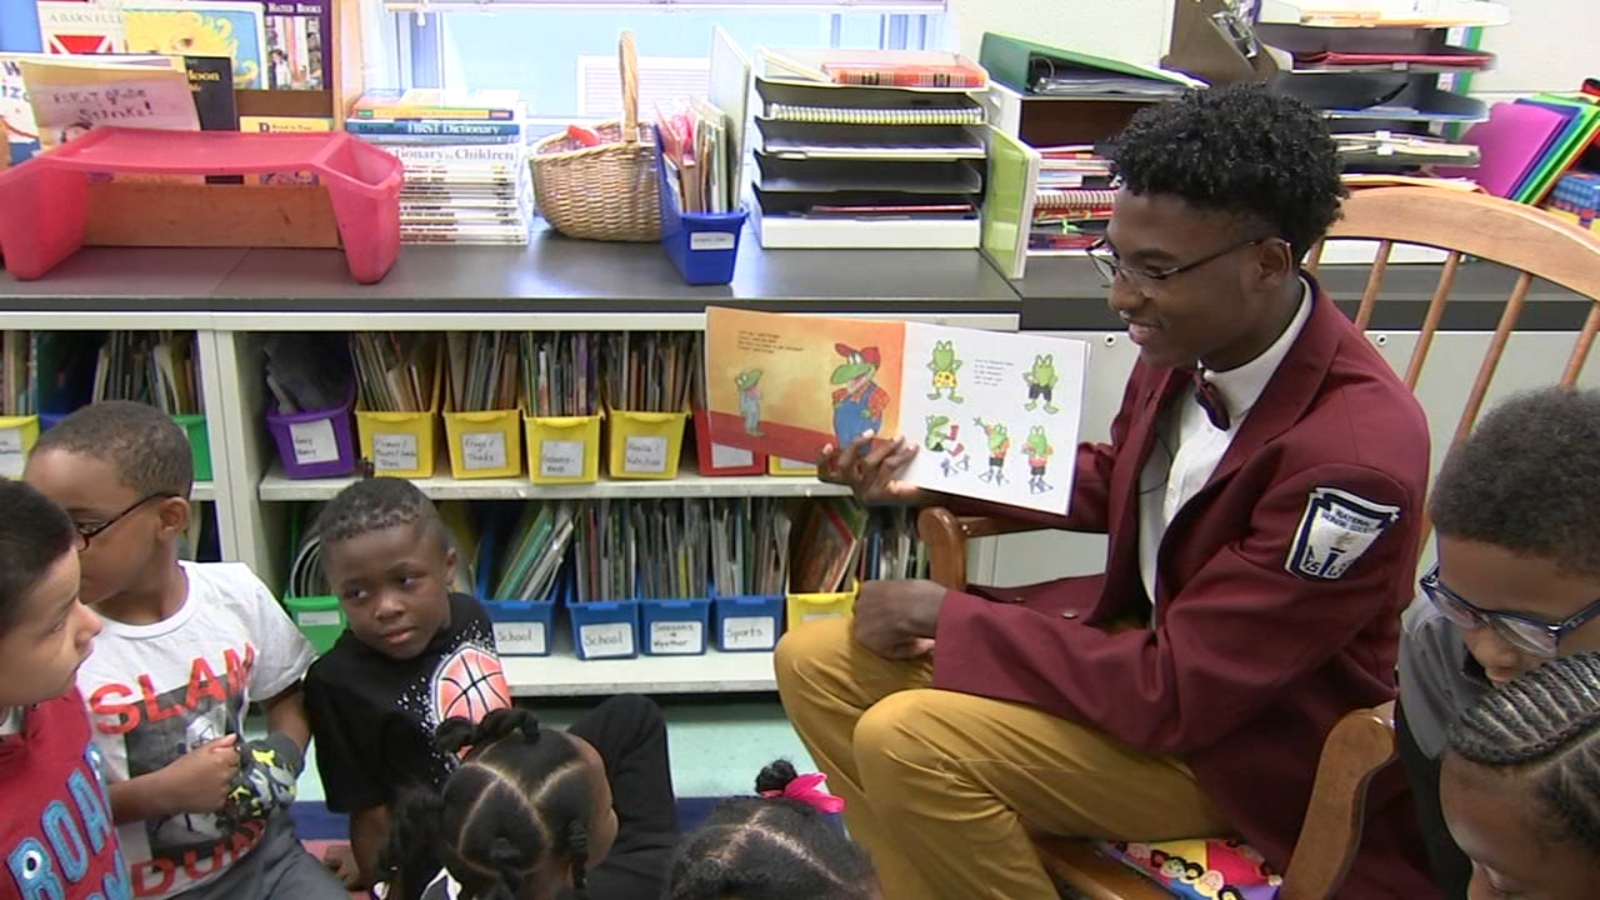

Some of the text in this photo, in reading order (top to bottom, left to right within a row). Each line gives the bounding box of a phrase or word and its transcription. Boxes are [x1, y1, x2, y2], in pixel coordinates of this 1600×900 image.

[297, 3, 322, 14] BOOKS
[443, 123, 501, 135] Dictionary
[394, 148, 443, 163] tionary
[455, 148, 515, 161] Children
[498, 629, 532, 642] School
[584, 629, 623, 646] School
[727, 627, 763, 642] Sports
[89, 642, 256, 735] SLAM
